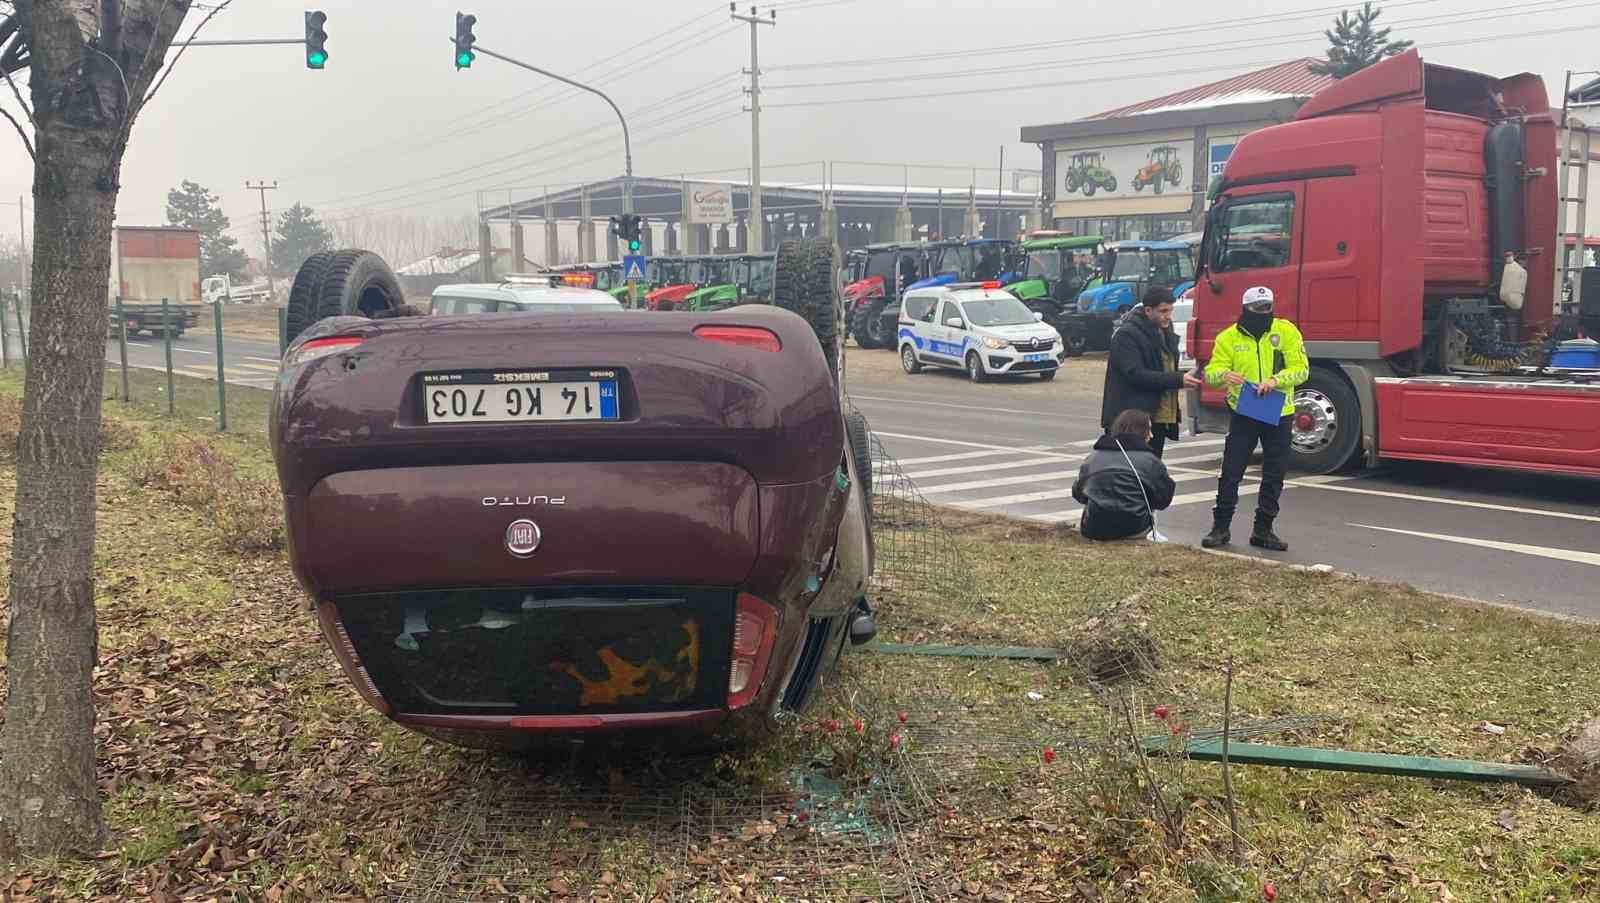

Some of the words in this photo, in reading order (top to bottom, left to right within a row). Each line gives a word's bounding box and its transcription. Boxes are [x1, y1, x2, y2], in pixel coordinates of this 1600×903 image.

[432, 389, 487, 416] 703
[506, 387, 542, 416] KG
[561, 386, 593, 414] 14
[601, 387, 614, 397] TR
[482, 495, 566, 506] PUNTO
[513, 528, 533, 545] FIAT
